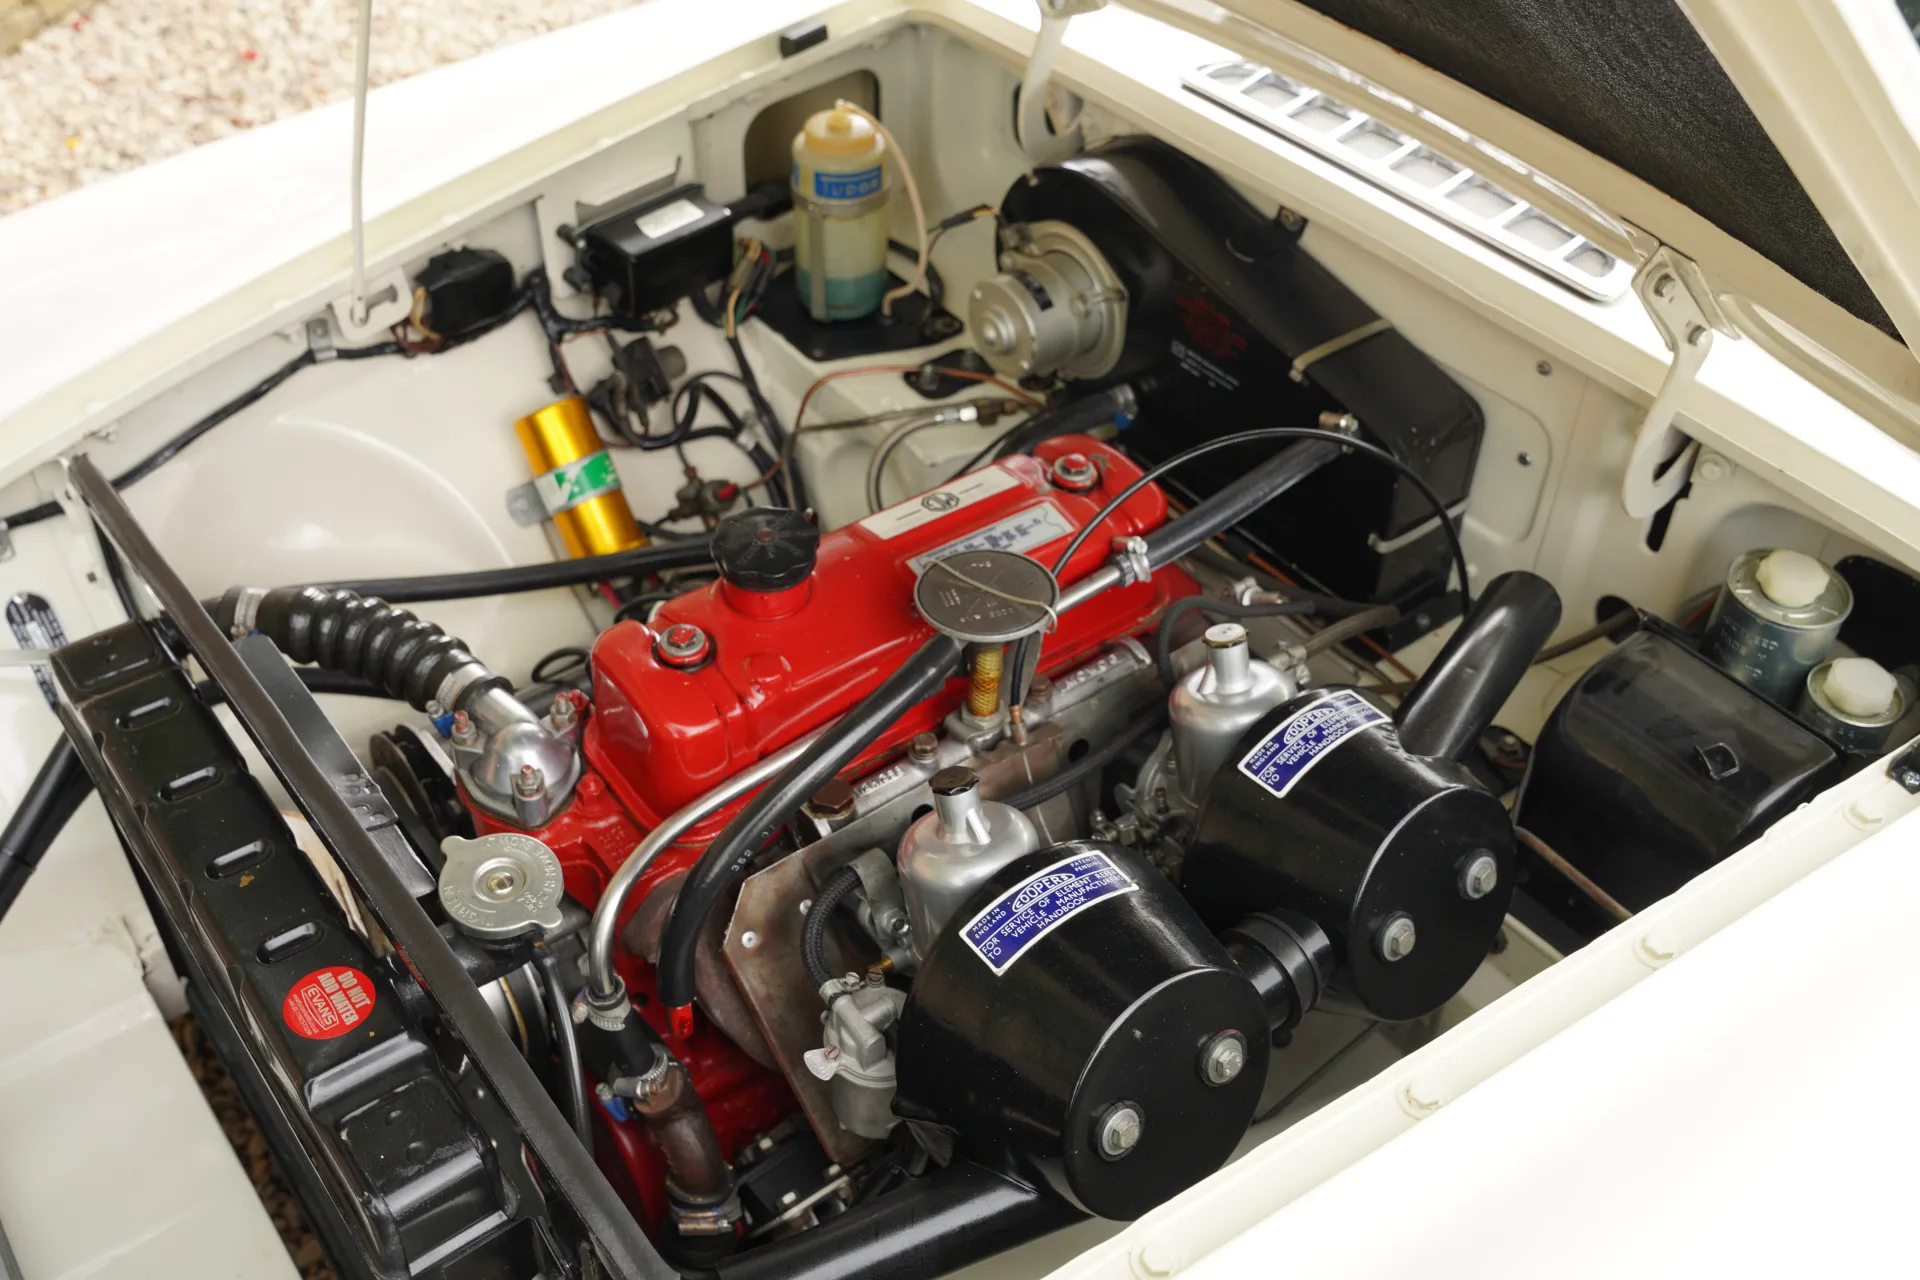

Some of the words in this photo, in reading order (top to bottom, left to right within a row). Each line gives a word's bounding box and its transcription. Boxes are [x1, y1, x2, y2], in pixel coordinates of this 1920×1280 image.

[1286, 709, 1330, 741] COOPERS
[1249, 748, 1266, 764] MADE
[1264, 740, 1274, 748] IN
[1251, 743, 1280, 770] ENGLAND
[1260, 766, 1278, 781] FOR
[1276, 739, 1306, 766] SERVICE
[1306, 729, 1318, 739] OF
[1266, 773, 1280, 786] TO
[1286, 740, 1317, 766] VEHICLE
[731, 849, 754, 872] 352
[1015, 874, 1069, 909] COOPERS
[972, 912, 991, 932] MADE
[991, 907, 1001, 915] IN
[974, 910, 1007, 939] ENGLAND
[982, 937, 1001, 954] FOR
[1000, 908, 1035, 937] SERVICE
[1038, 896, 1051, 908] OF
[1054, 876, 1092, 898] ELEMENT
[987, 947, 1002, 960] TO
[1011, 909, 1048, 938] VEHICLE
[338, 970, 358, 989] DO
[307, 987, 336, 1025] EVANS
[317, 972, 340, 994] ADD
[329, 990, 359, 1026] WATER
[347, 985, 371, 1009] NOT
